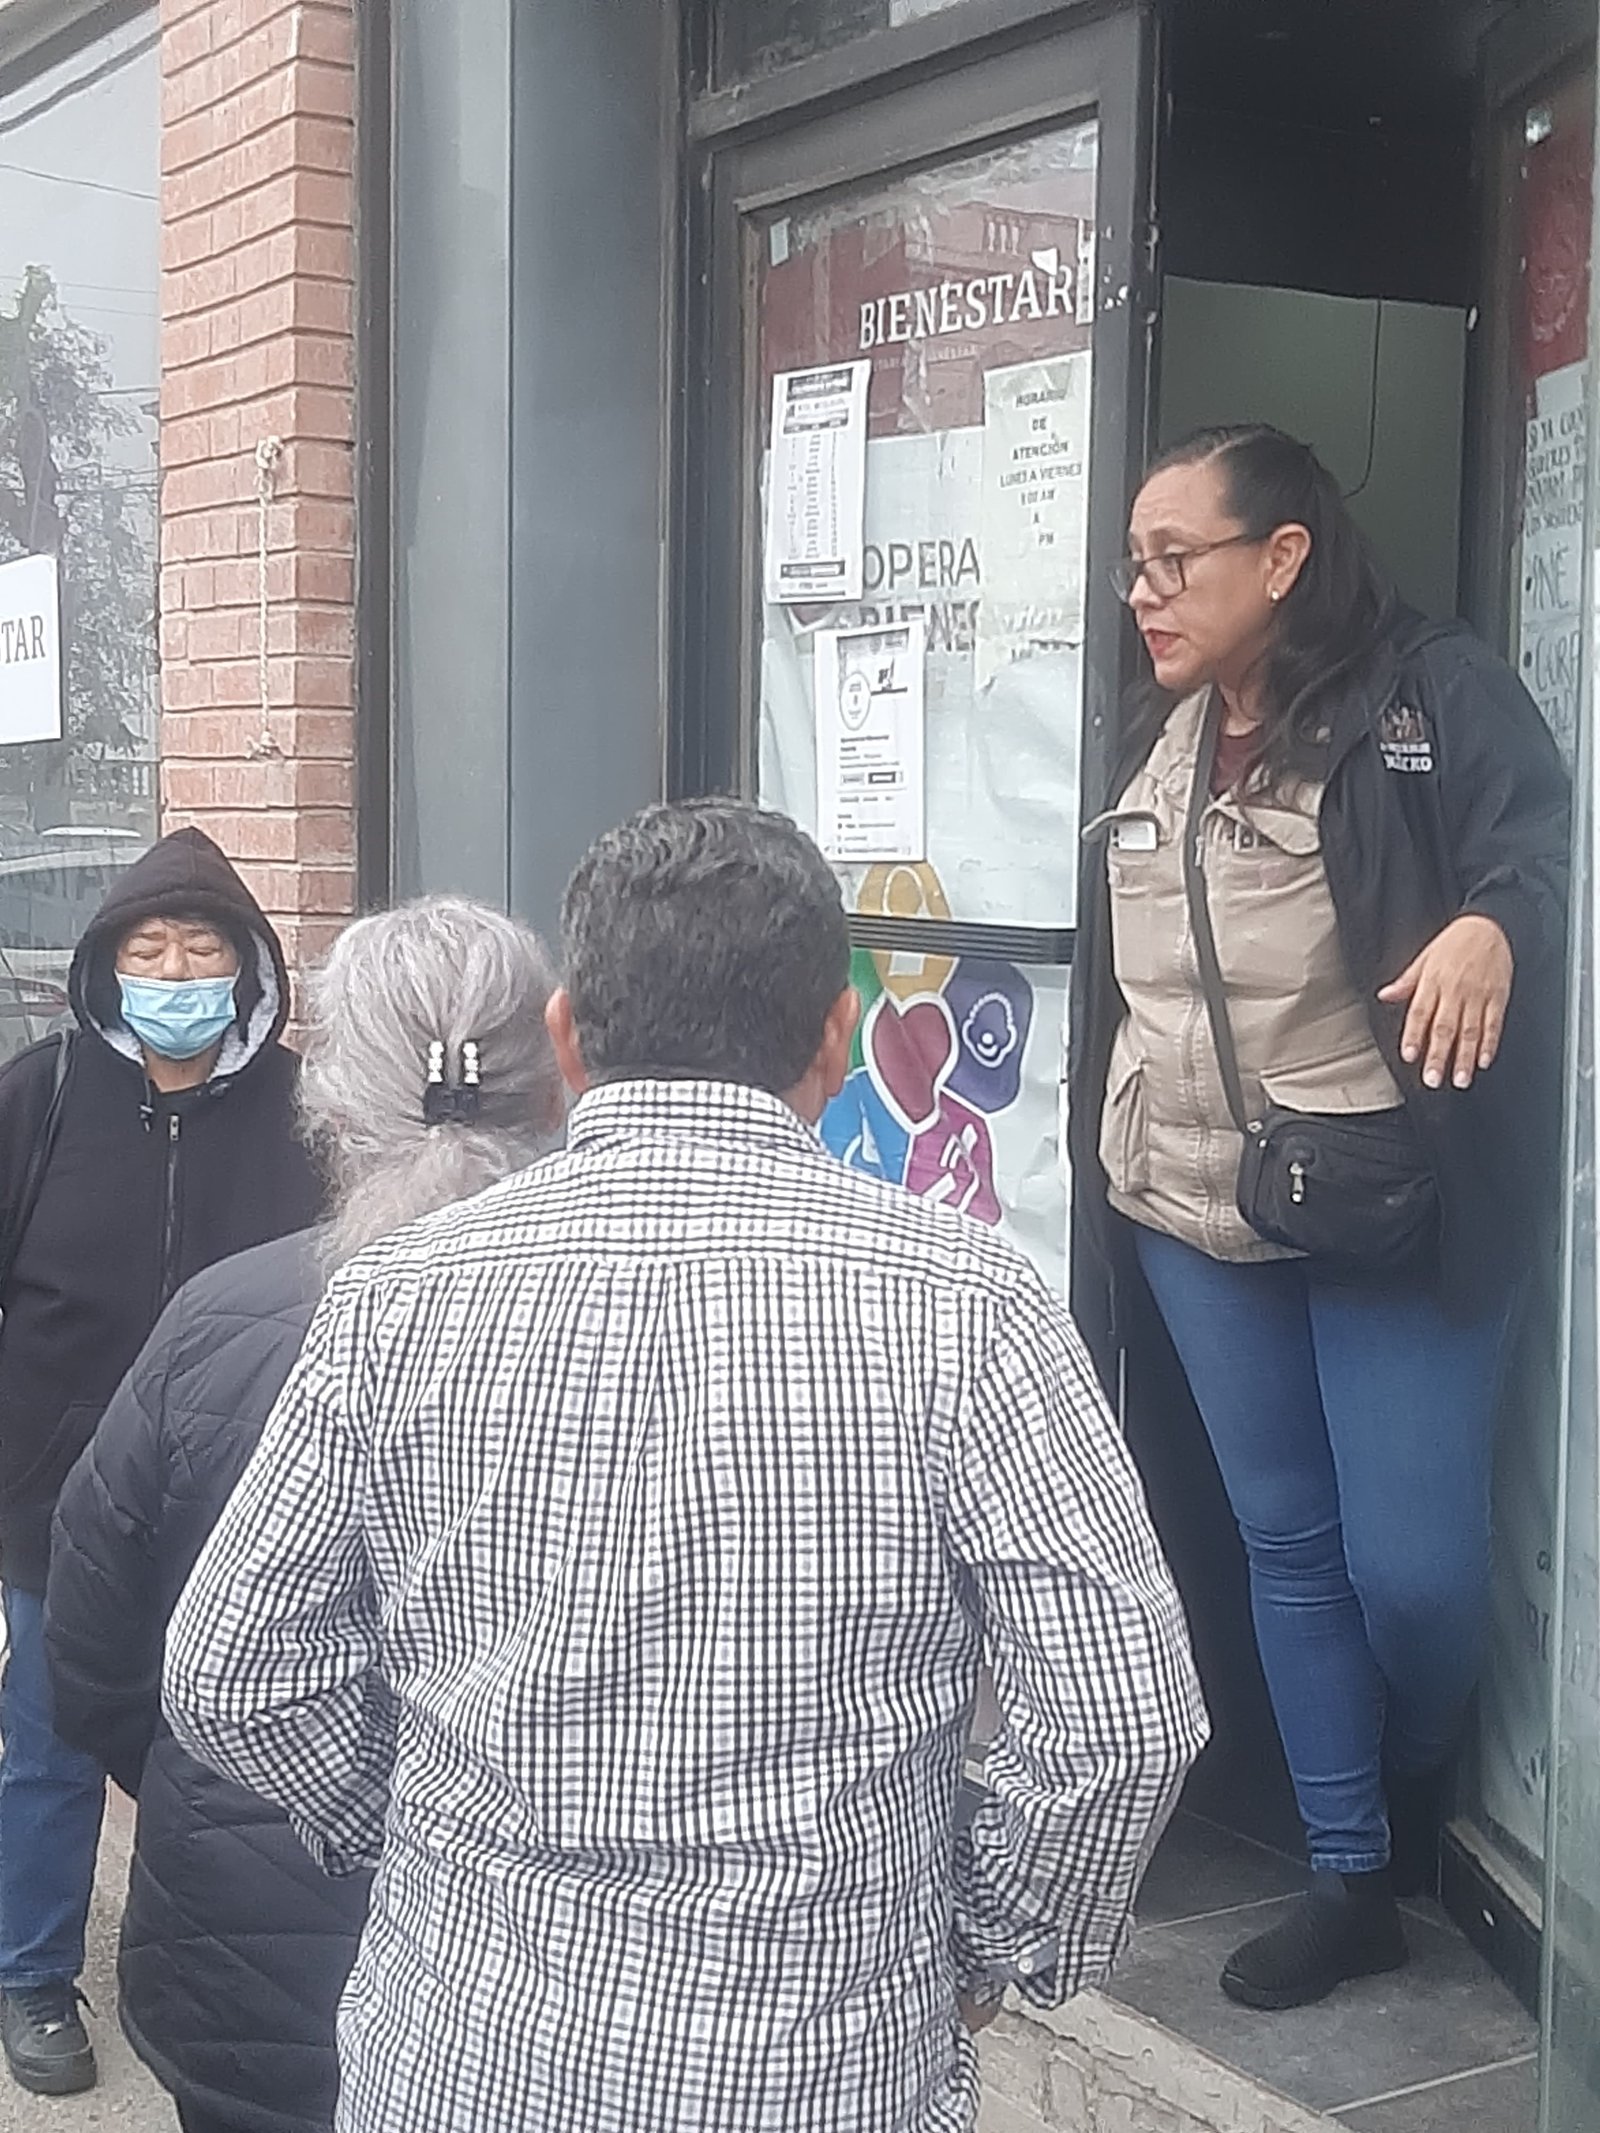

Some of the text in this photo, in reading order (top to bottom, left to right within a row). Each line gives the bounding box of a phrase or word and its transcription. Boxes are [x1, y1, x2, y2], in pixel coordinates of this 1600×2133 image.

[859, 265, 1074, 350] BIENESTAR
[1032, 416, 1047, 431] DE
[1029, 468, 1037, 482] A
[863, 538, 980, 590] OPERA
[1, 614, 46, 664] TAR
